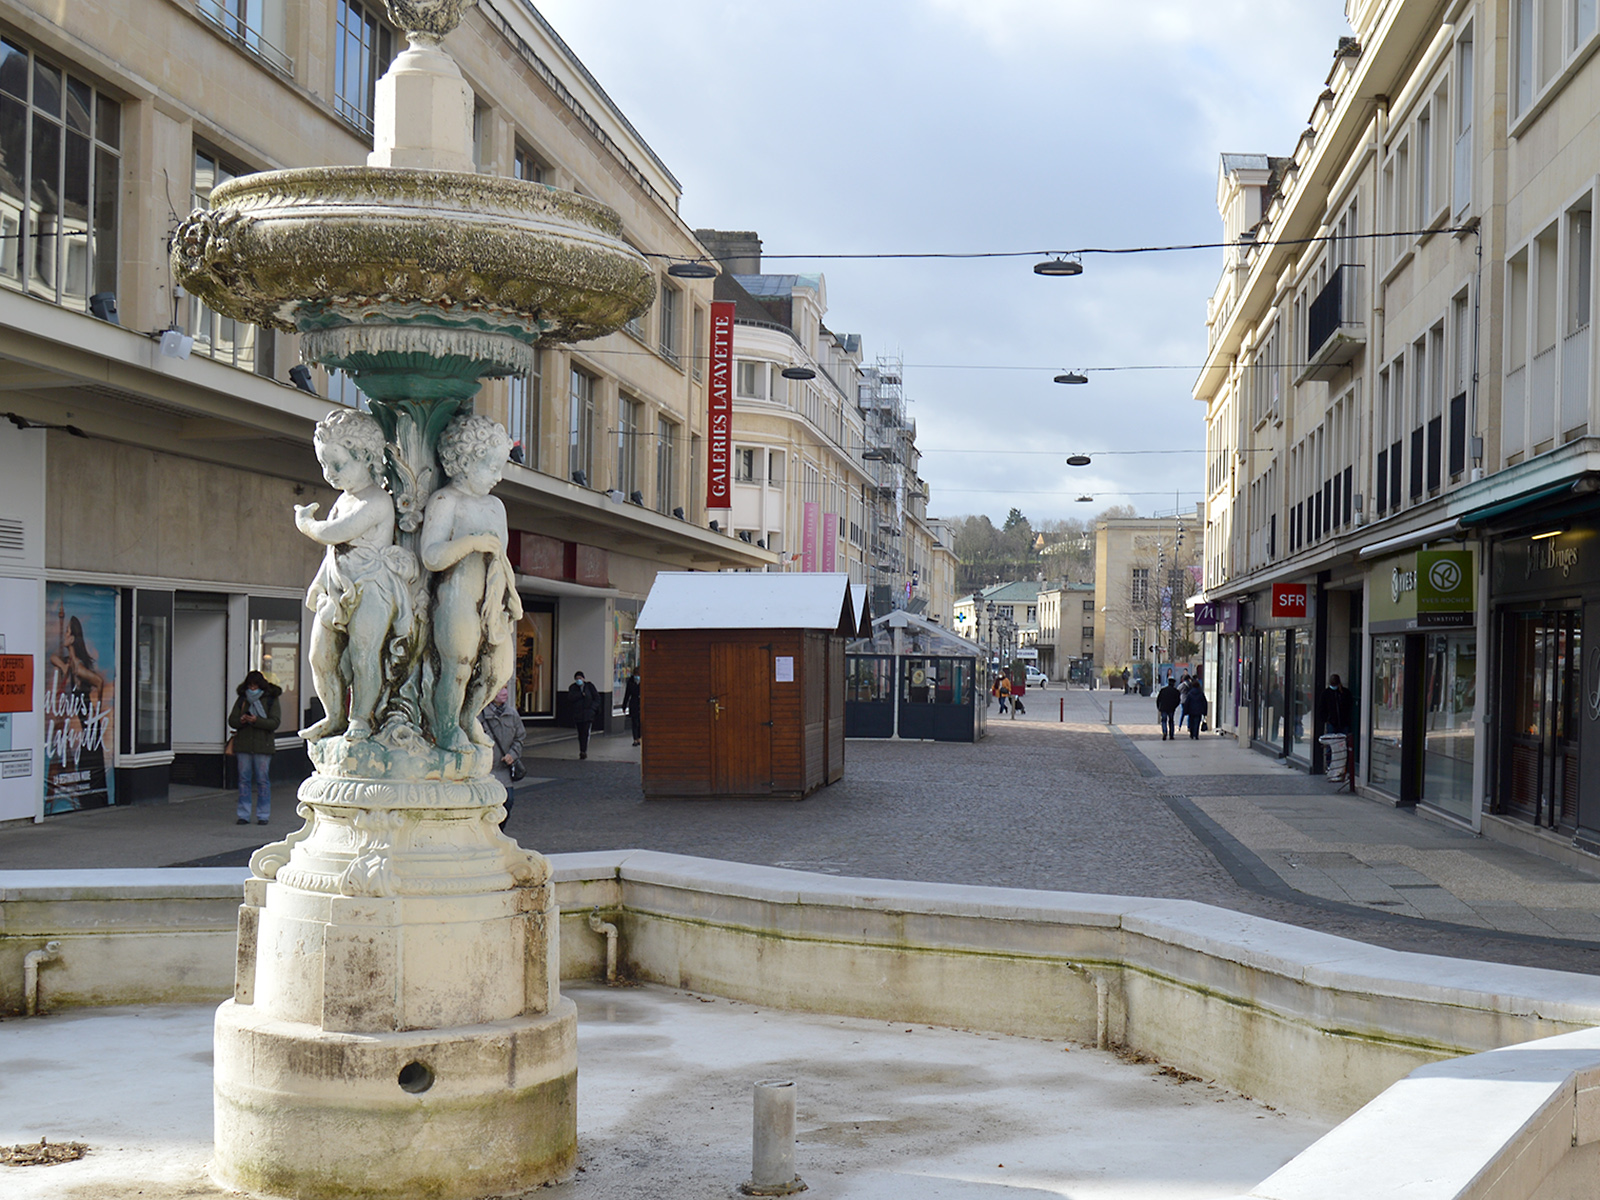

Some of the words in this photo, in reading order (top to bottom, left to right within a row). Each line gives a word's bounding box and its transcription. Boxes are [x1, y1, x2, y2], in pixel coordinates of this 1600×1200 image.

[713, 315, 730, 410] LAFAYETTE
[712, 415, 729, 497] GALERIES
[1547, 536, 1579, 578] Bruges
[1279, 593, 1305, 607] SFR
[1427, 615, 1464, 623] L'INSTITUT
[2, 657, 24, 669] OFFERTS
[44, 669, 87, 717] aleries
